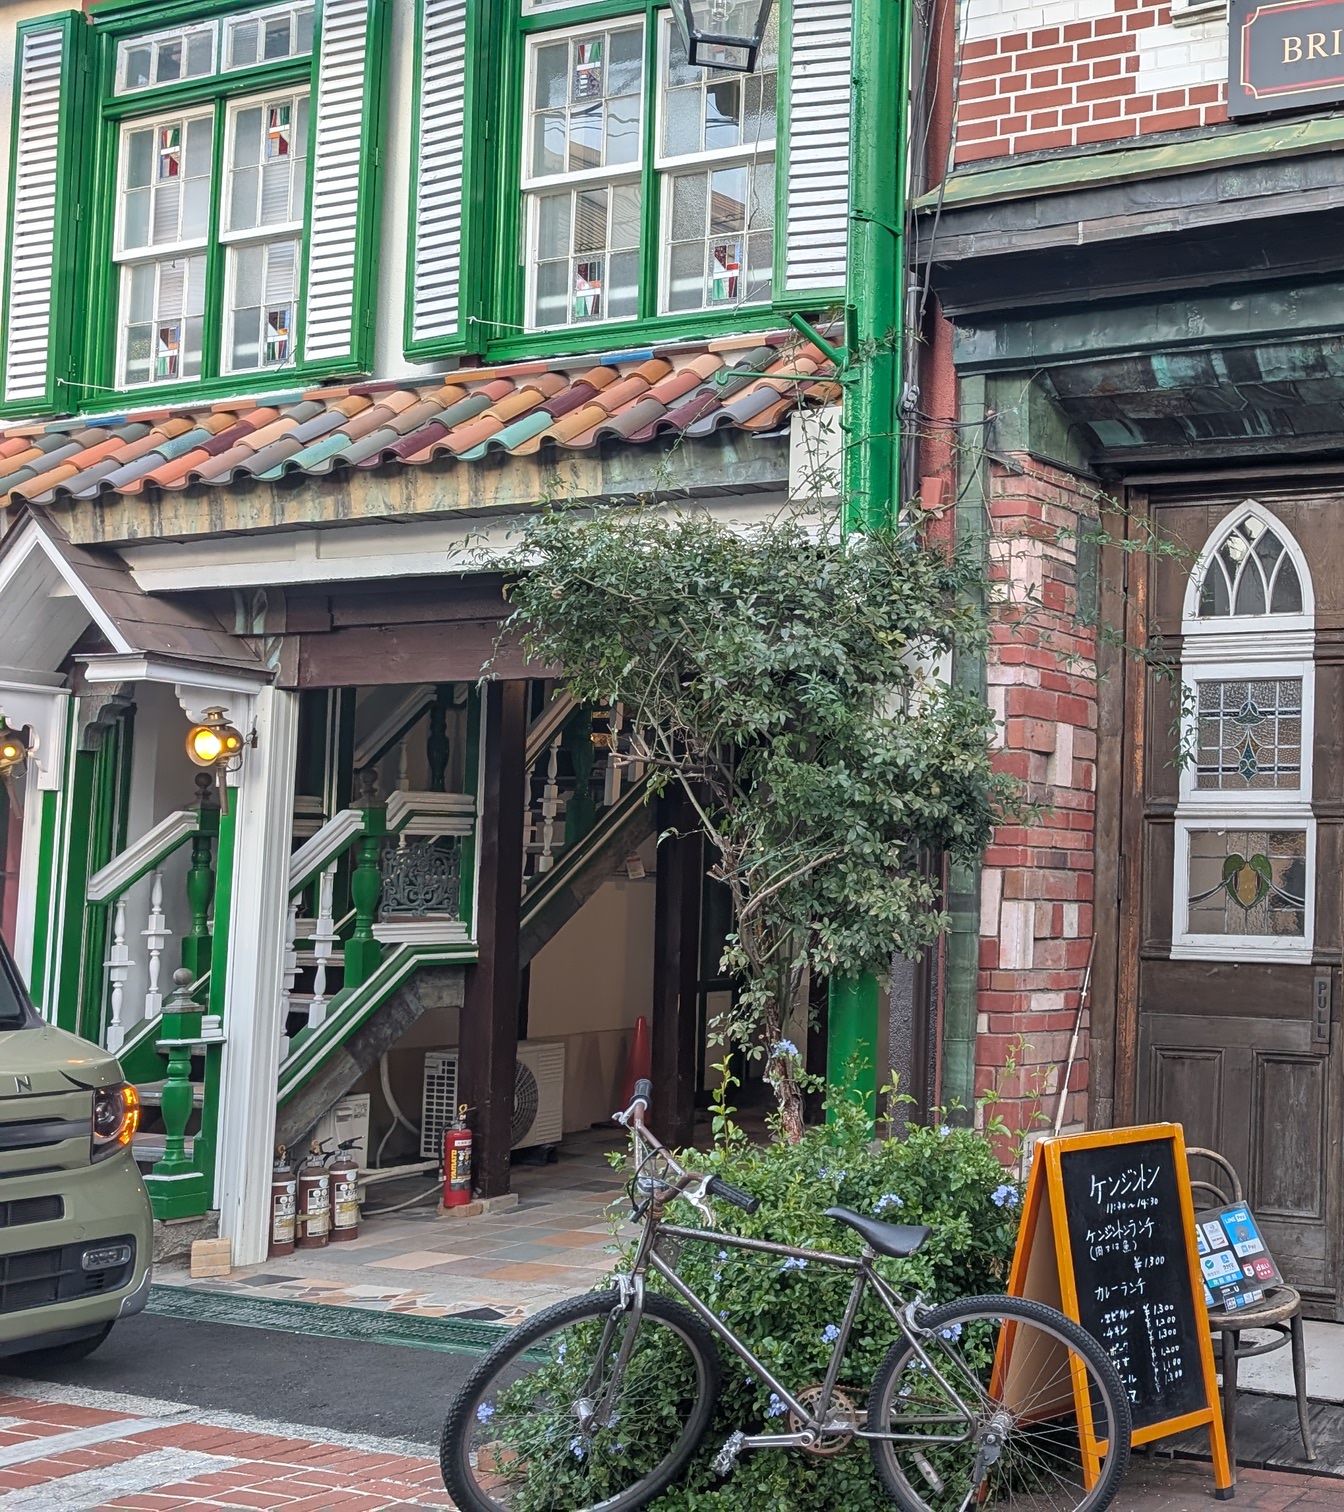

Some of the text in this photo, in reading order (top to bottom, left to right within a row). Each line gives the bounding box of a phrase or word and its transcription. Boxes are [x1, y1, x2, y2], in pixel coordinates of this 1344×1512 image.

[1090, 1163, 1160, 1204] ケンジントン
[1086, 1217, 1155, 1243] ケンジントンランチ
[1094, 1278, 1146, 1301] カレーランチ
